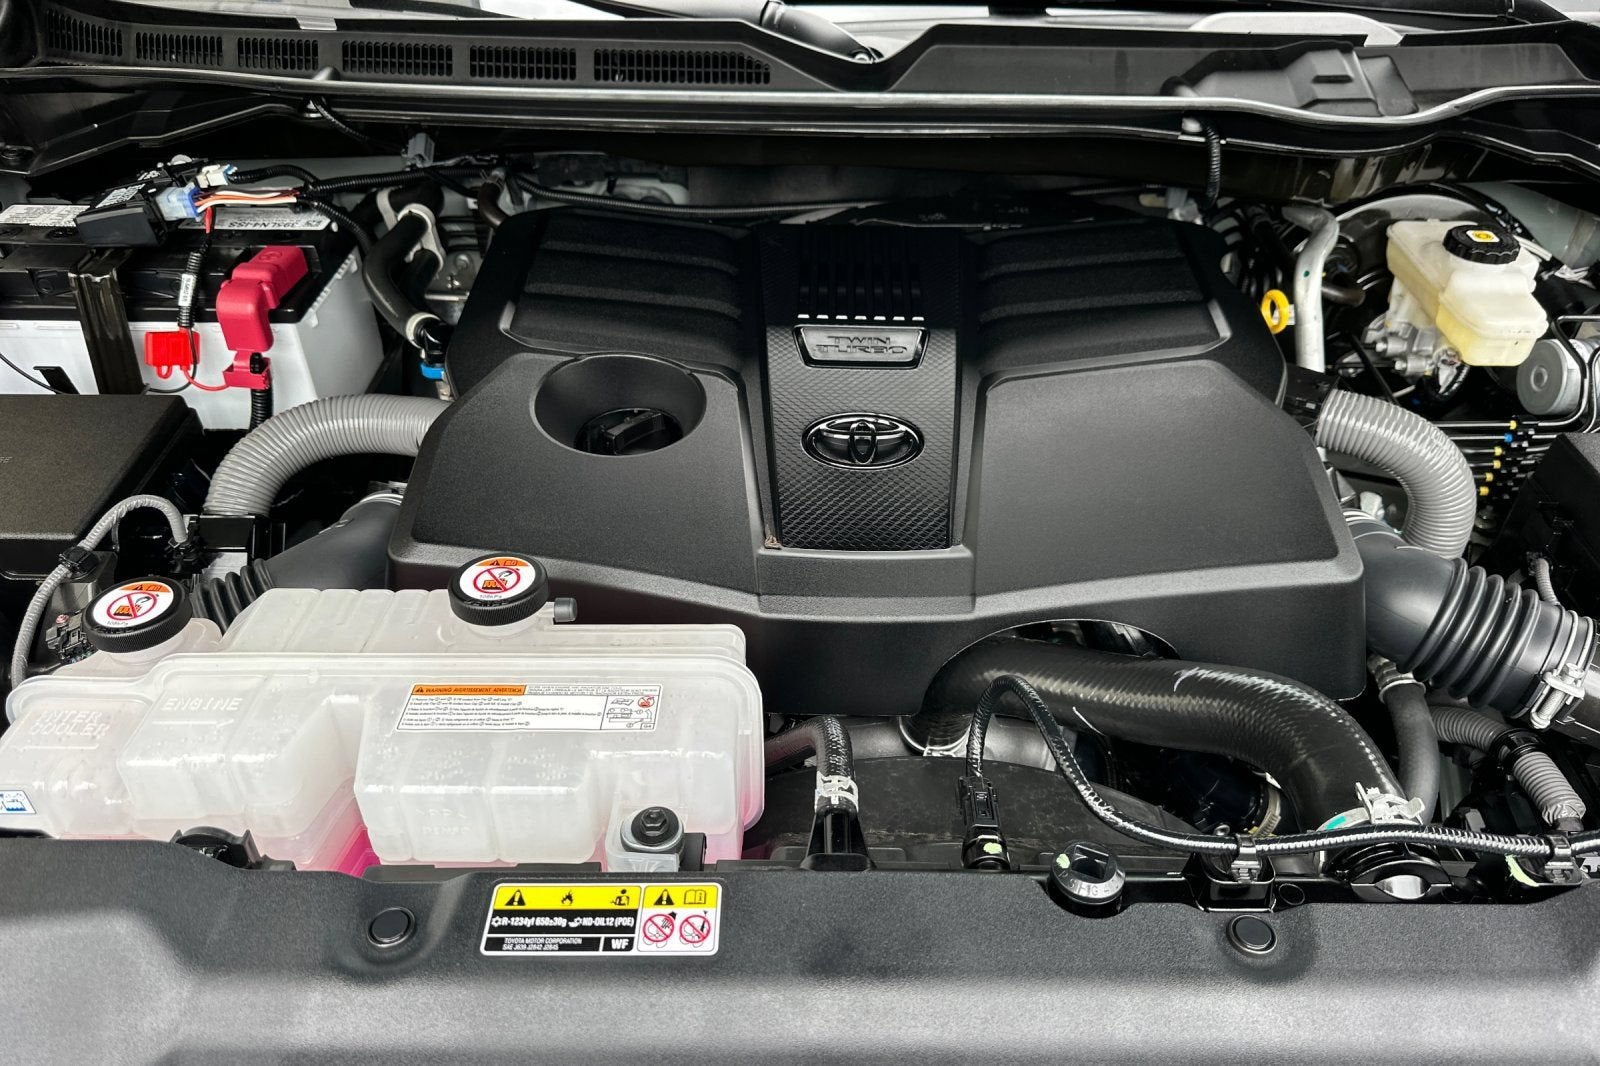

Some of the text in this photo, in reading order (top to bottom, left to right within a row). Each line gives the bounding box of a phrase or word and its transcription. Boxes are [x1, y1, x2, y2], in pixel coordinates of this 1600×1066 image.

[827, 335, 891, 345] TWIN
[816, 344, 908, 354] TURBO
[160, 697, 243, 711] ENGINE
[36, 710, 103, 723] INTER
[29, 722, 110, 737] COOLER
[611, 938, 629, 950] WF
